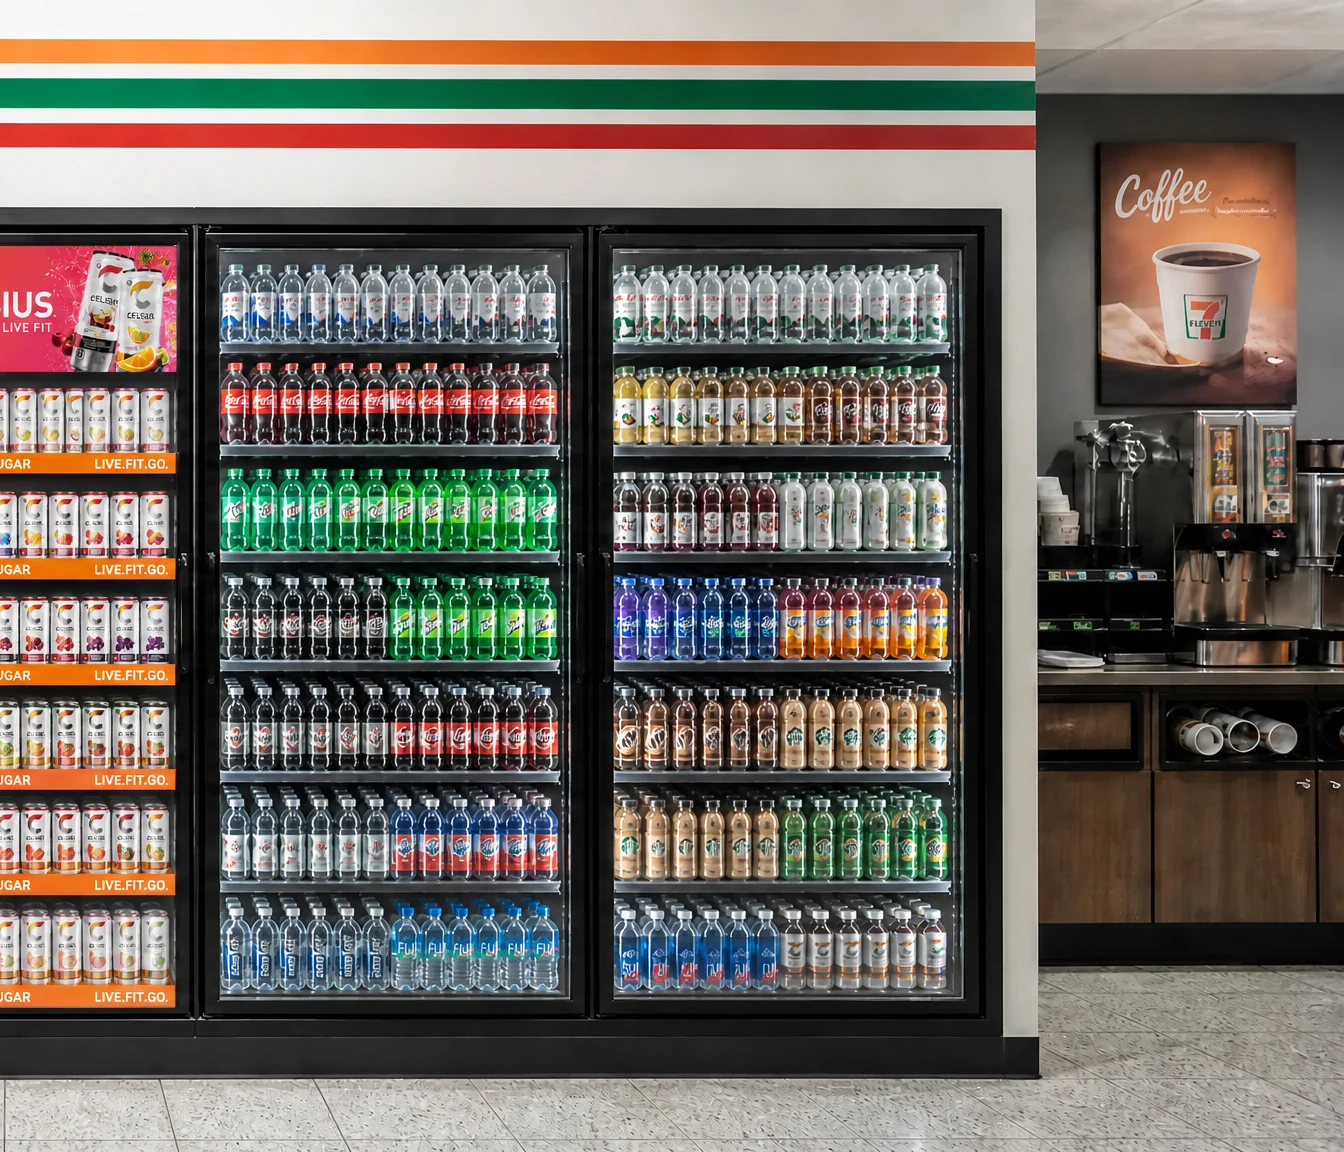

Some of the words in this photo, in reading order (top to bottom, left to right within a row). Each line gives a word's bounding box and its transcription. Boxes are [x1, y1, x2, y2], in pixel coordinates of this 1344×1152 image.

[1114, 167, 1212, 224] Coffee
[2, 322, 29, 333] LIVE
[33, 322, 52, 333] FIT
